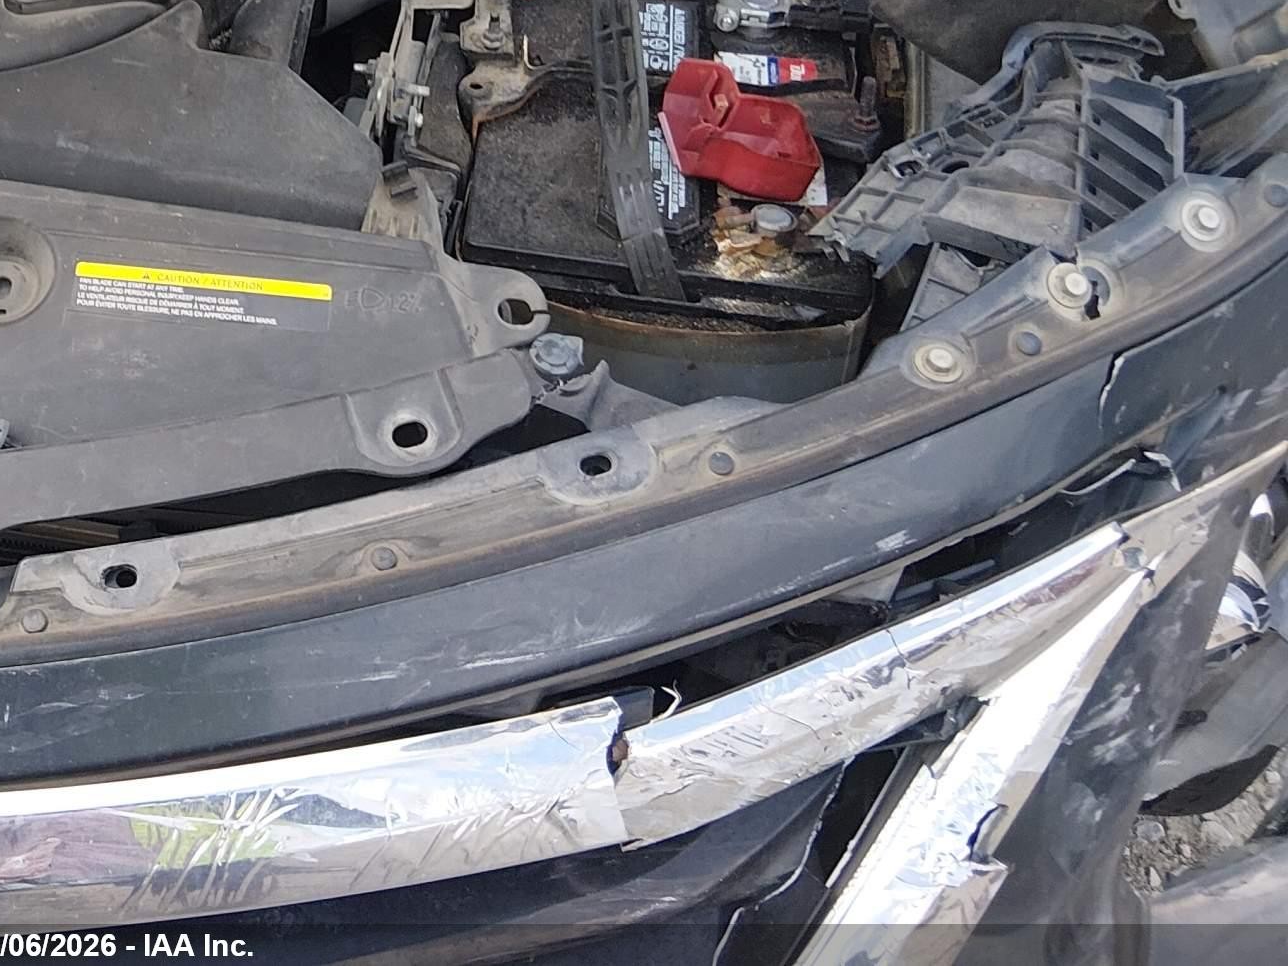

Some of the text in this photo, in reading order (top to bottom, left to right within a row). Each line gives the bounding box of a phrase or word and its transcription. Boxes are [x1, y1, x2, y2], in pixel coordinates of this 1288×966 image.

[113, 280, 126, 288] CAN
[127, 282, 146, 290] START
[157, 274, 200, 284] CAUTION
[210, 279, 263, 291] ATTENTION
[88, 285, 104, 293] HELP
[76, 298, 94, 306] POUR
[117, 303, 136, 311] TOUTE
[204, 312, 243, 322] APPROCHER
[243, 315, 255, 323] LES
[199, 303, 215, 311] TOUT
